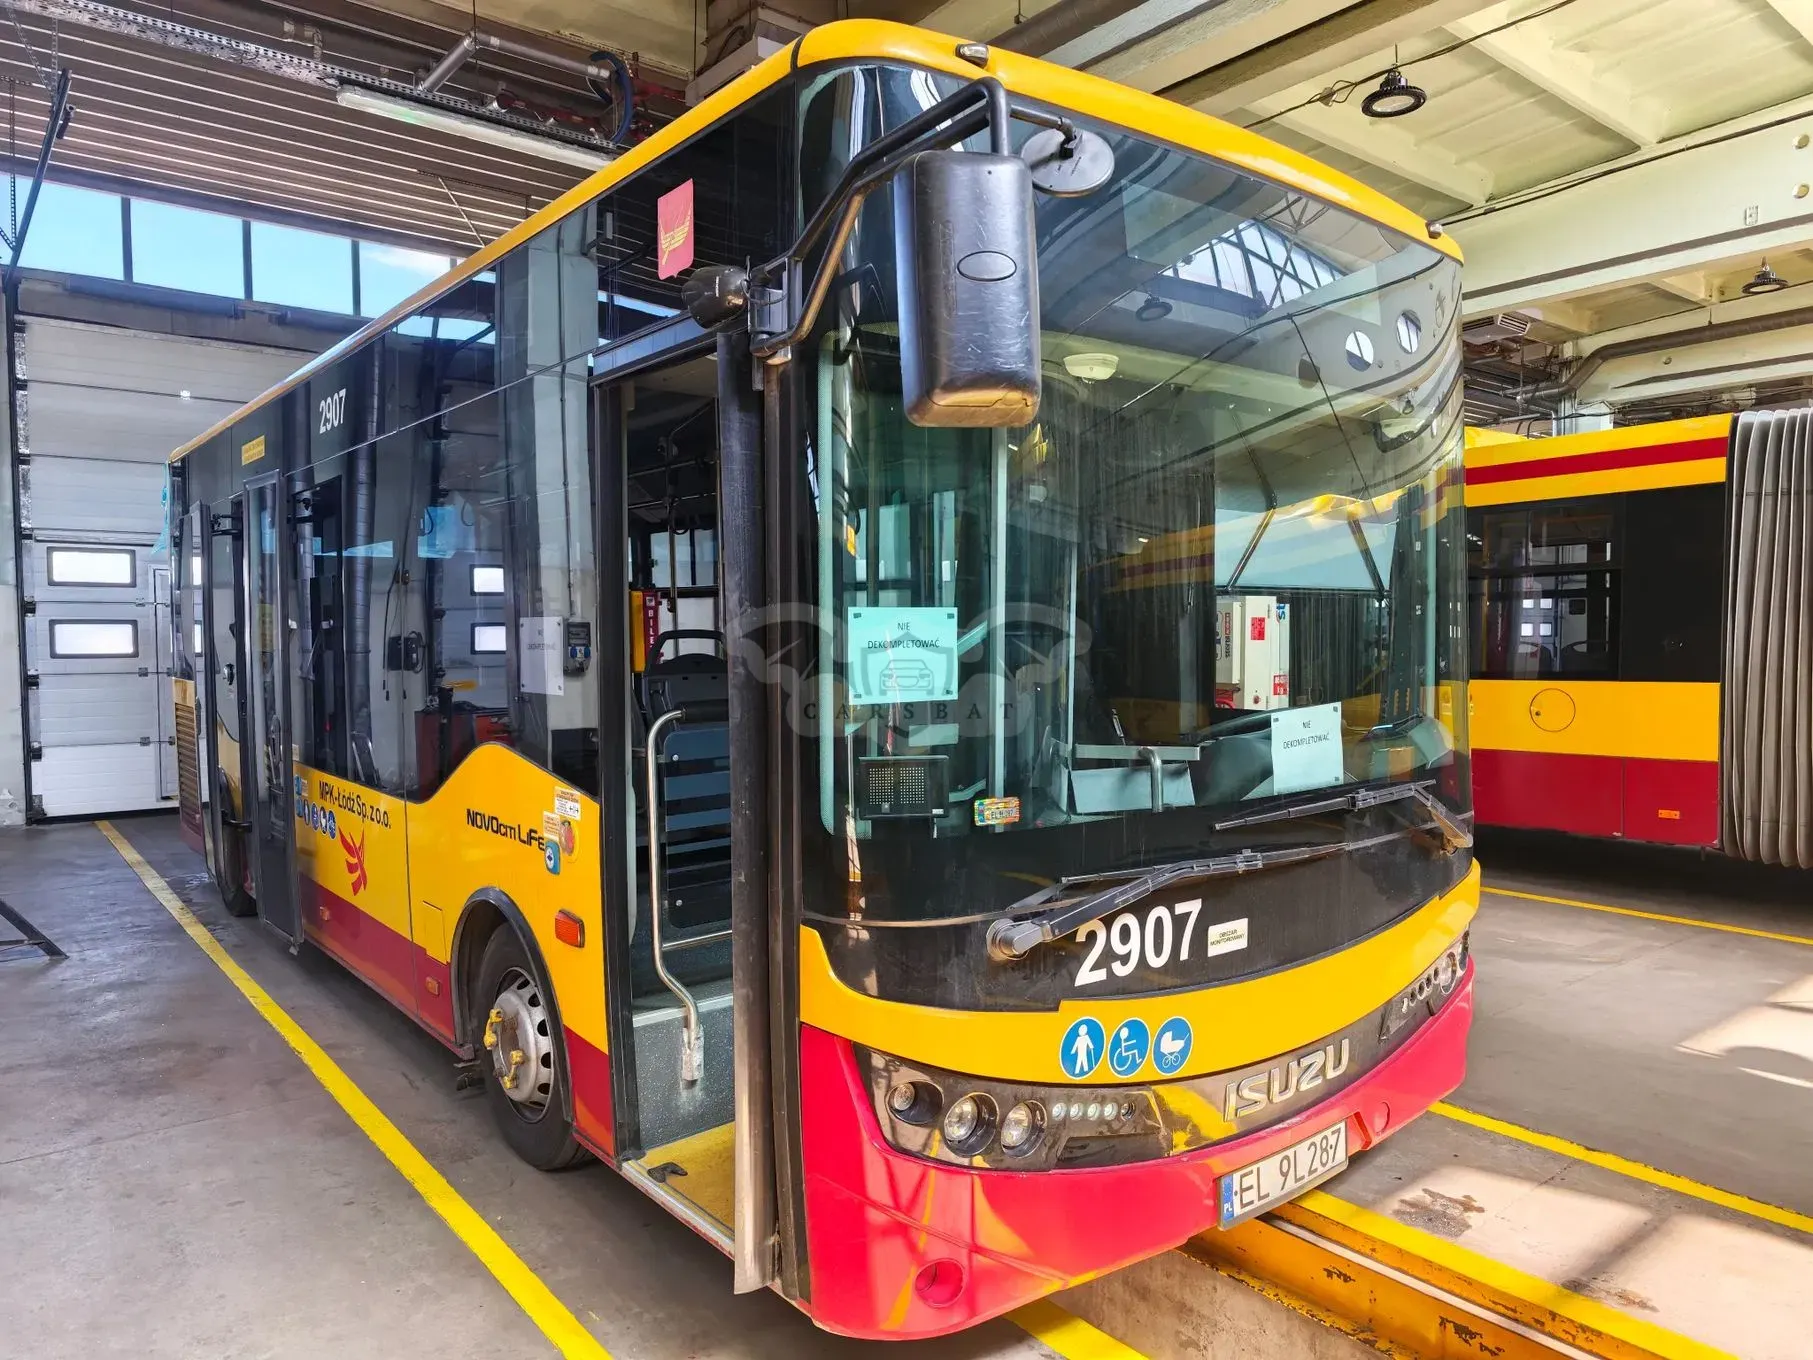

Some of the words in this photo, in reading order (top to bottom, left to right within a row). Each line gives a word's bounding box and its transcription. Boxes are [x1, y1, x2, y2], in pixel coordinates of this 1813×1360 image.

[319, 388, 347, 434] 2907
[897, 621, 911, 631] NIE
[867, 636, 941, 649] DEKOMPLETOWAĆ
[1302, 720, 1312, 729] NIE
[1282, 732, 1330, 750] DEKOMPLETOWAĆ
[1074, 898, 1202, 987] 2907
[1223, 1038, 1349, 1122] ISUZU
[1239, 1166, 1270, 1210] EL
[1279, 1127, 1342, 1192] 9L287
[1223, 1202, 1233, 1213] PL
